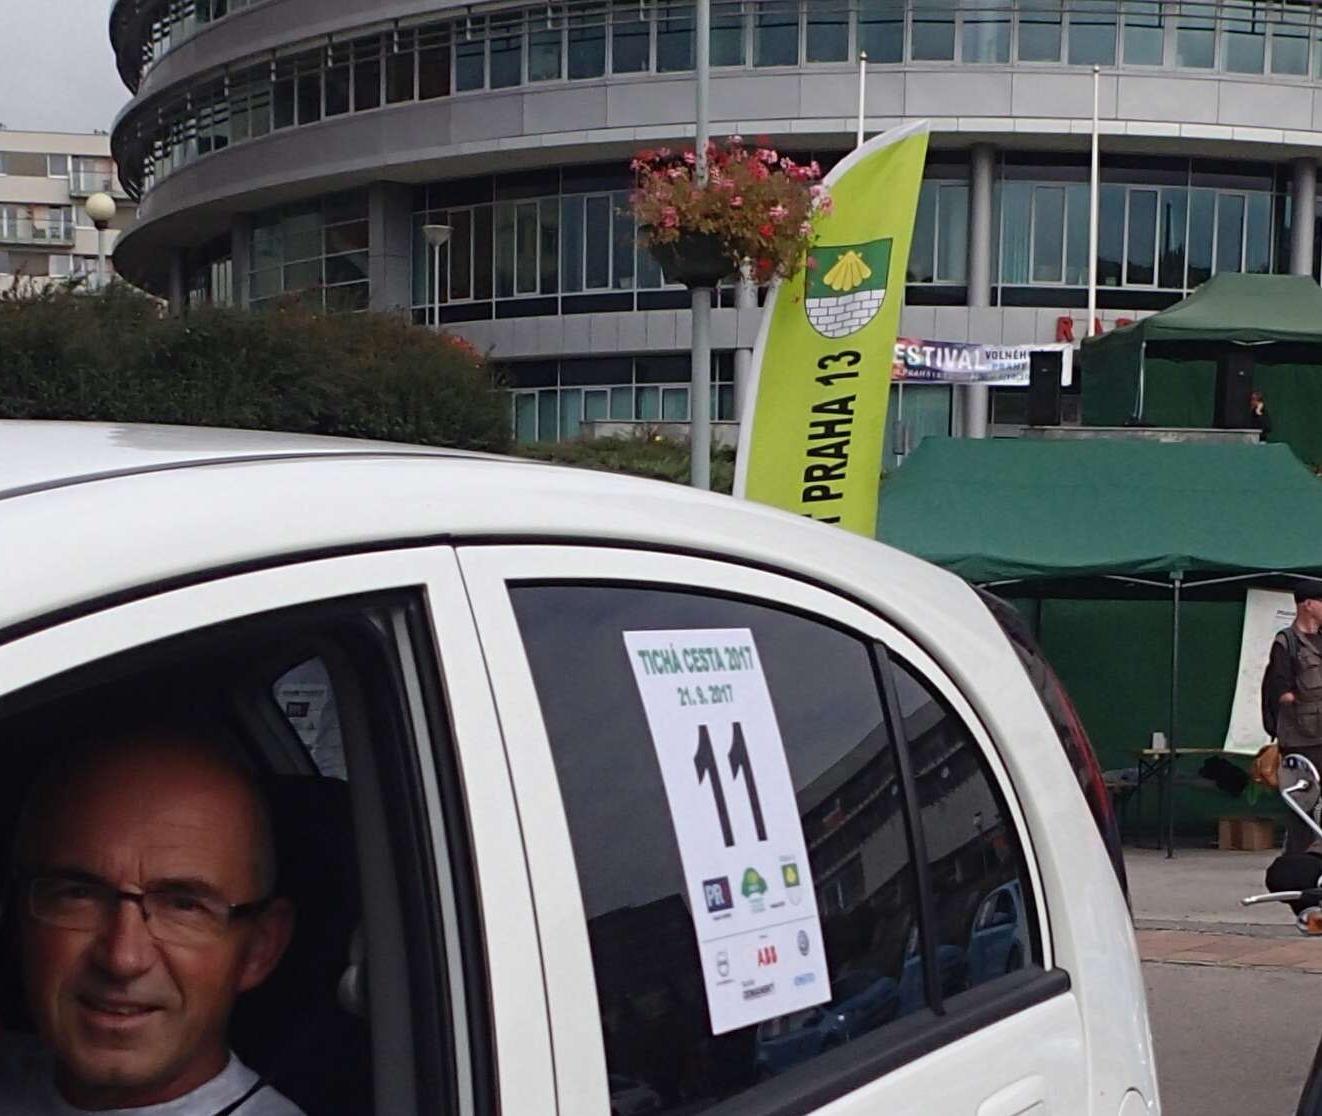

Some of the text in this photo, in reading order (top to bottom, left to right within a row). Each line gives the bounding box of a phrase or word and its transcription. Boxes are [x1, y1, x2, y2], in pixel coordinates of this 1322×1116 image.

[815, 350, 861, 386] 13
[802, 394, 856, 502] PRAHA
[637, 643, 754, 675] TICHÁ CESTA 2017
[708, 684, 733, 703] 2017
[693, 721, 768, 848] 11
